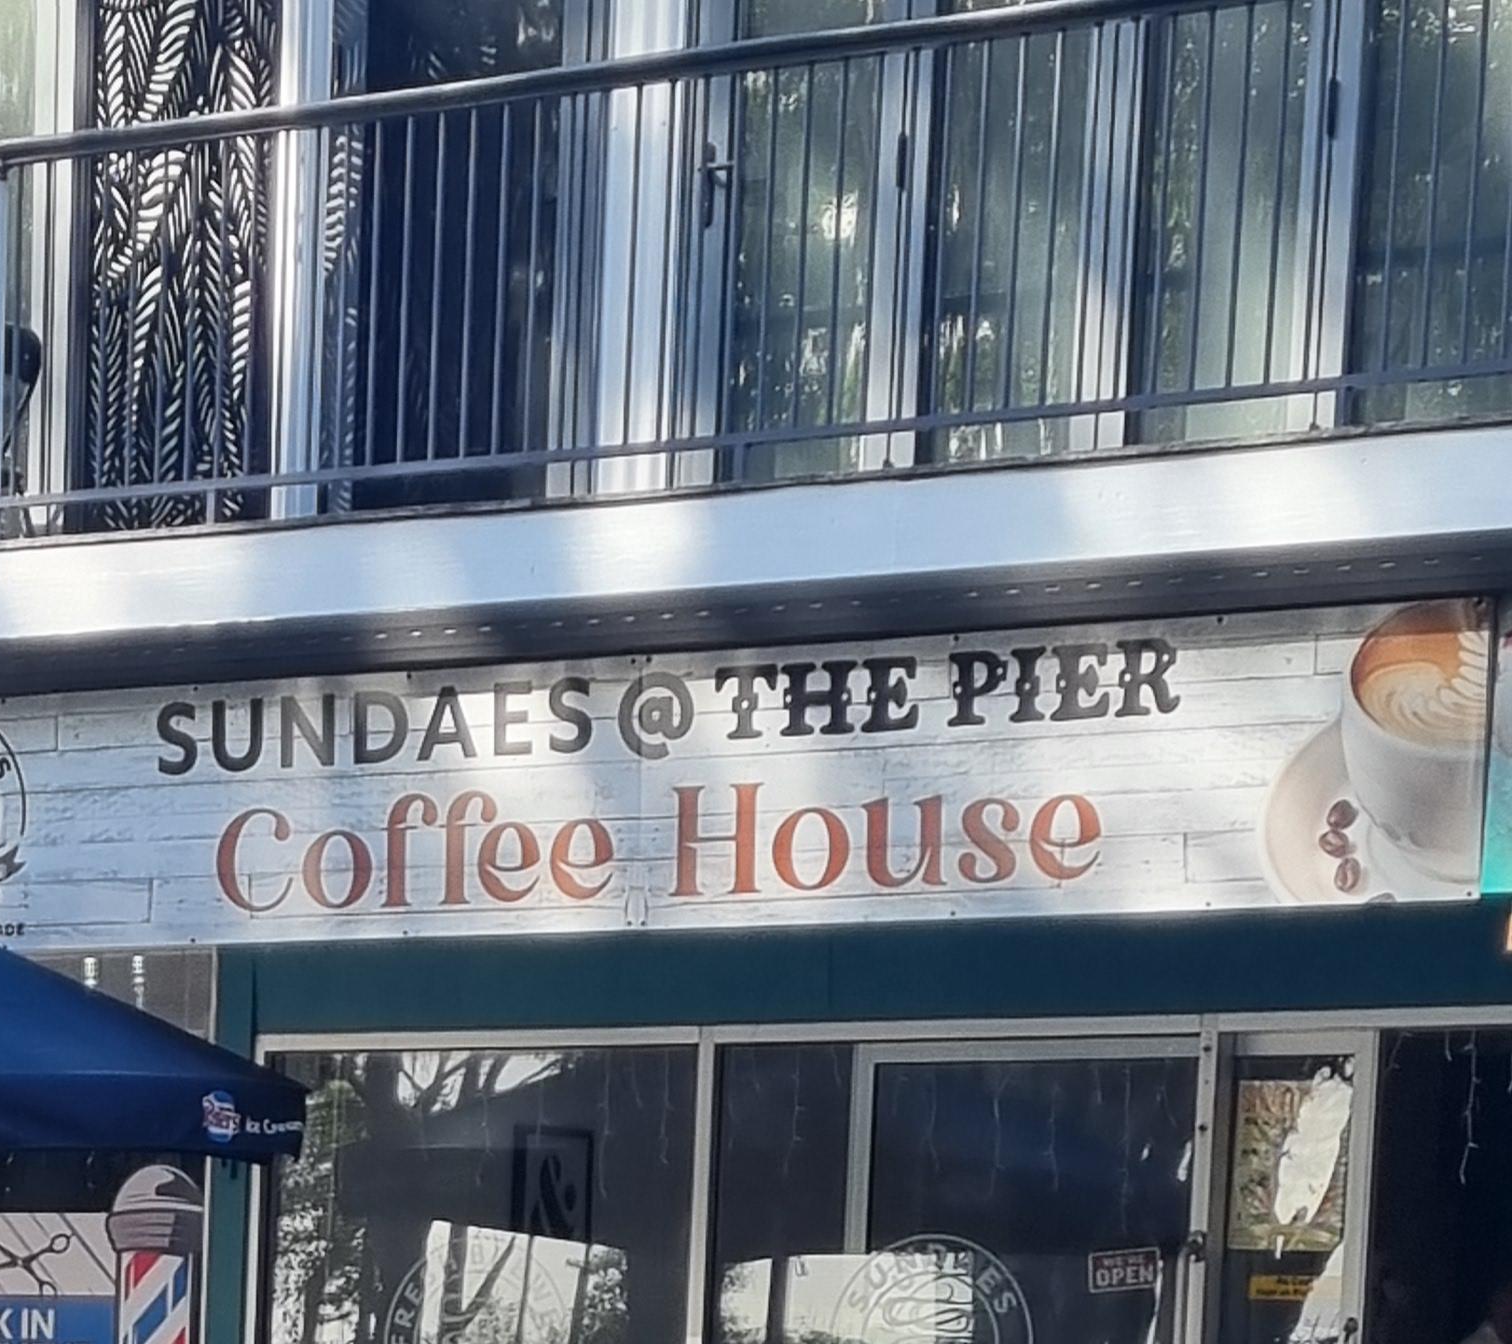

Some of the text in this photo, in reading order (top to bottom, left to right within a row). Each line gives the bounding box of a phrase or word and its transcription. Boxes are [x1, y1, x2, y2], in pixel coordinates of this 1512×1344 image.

[157, 638, 1181, 776] SUNDAES @ THE PIER
[215, 782, 1102, 912] Coffee House
[1095, 1264, 1154, 1287] OPEN
[21, 1308, 56, 1340] IN
